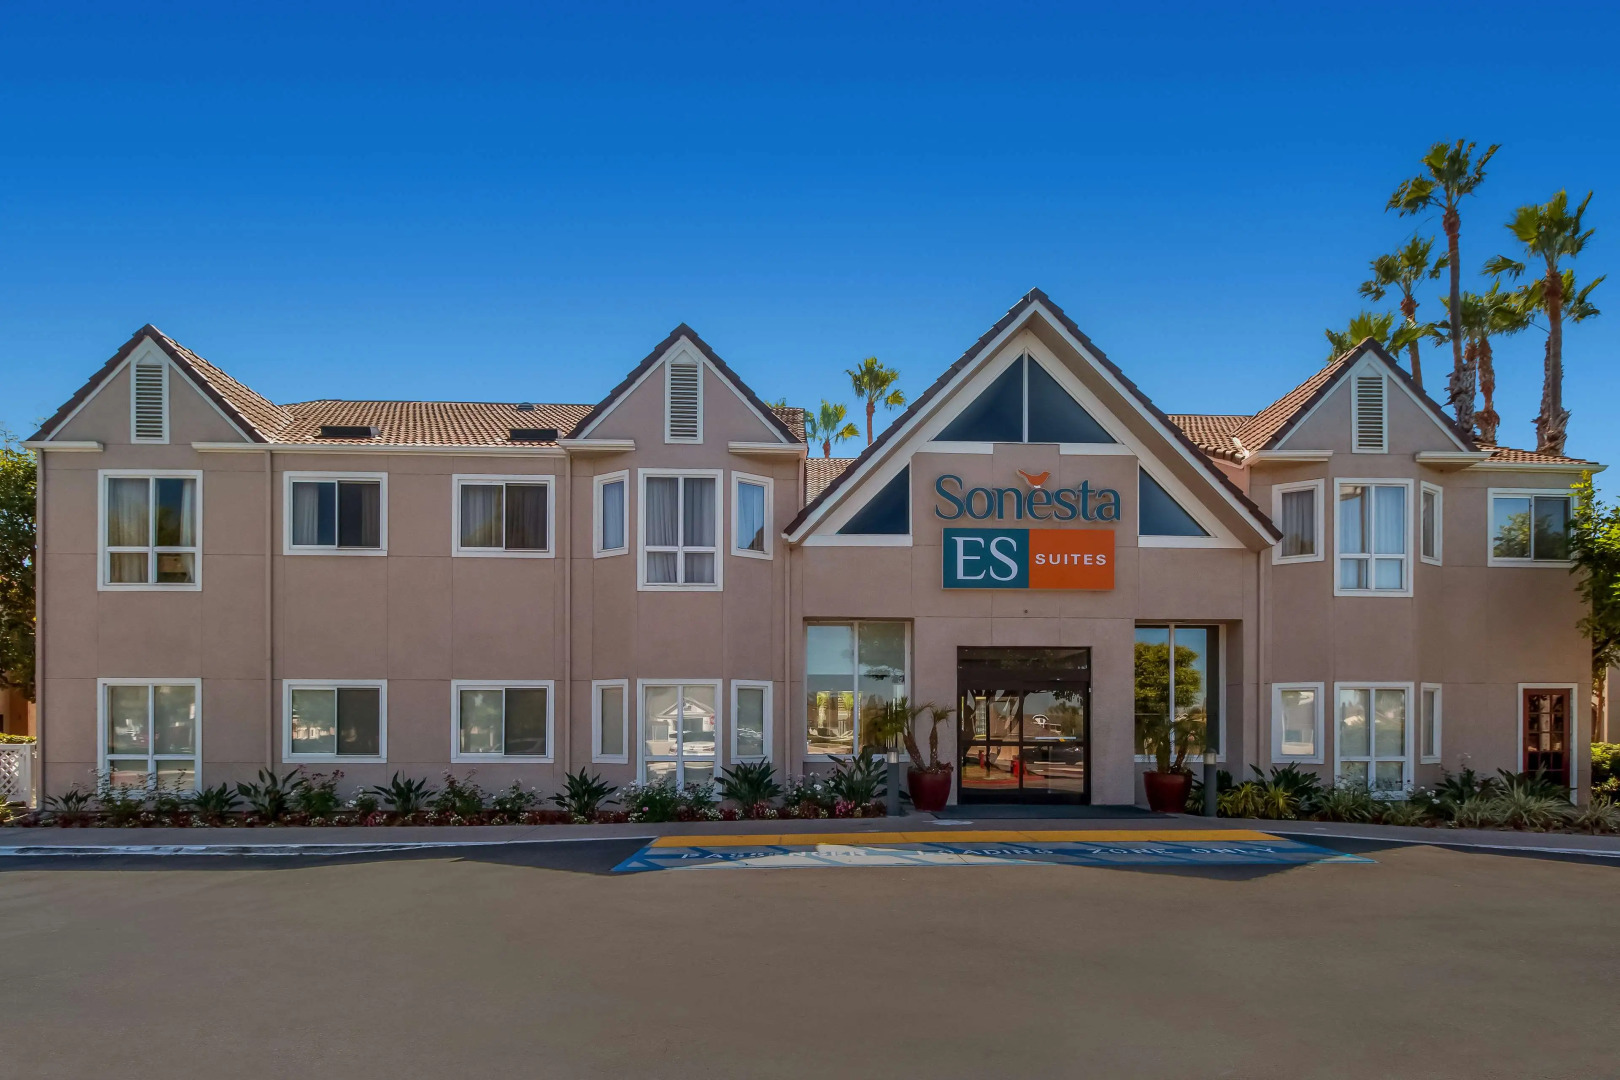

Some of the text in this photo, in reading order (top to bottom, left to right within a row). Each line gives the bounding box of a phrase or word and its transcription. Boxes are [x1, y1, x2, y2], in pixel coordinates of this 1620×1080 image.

[935, 474, 1121, 521] Sonesta
[951, 536, 1107, 582] ES SUITES
